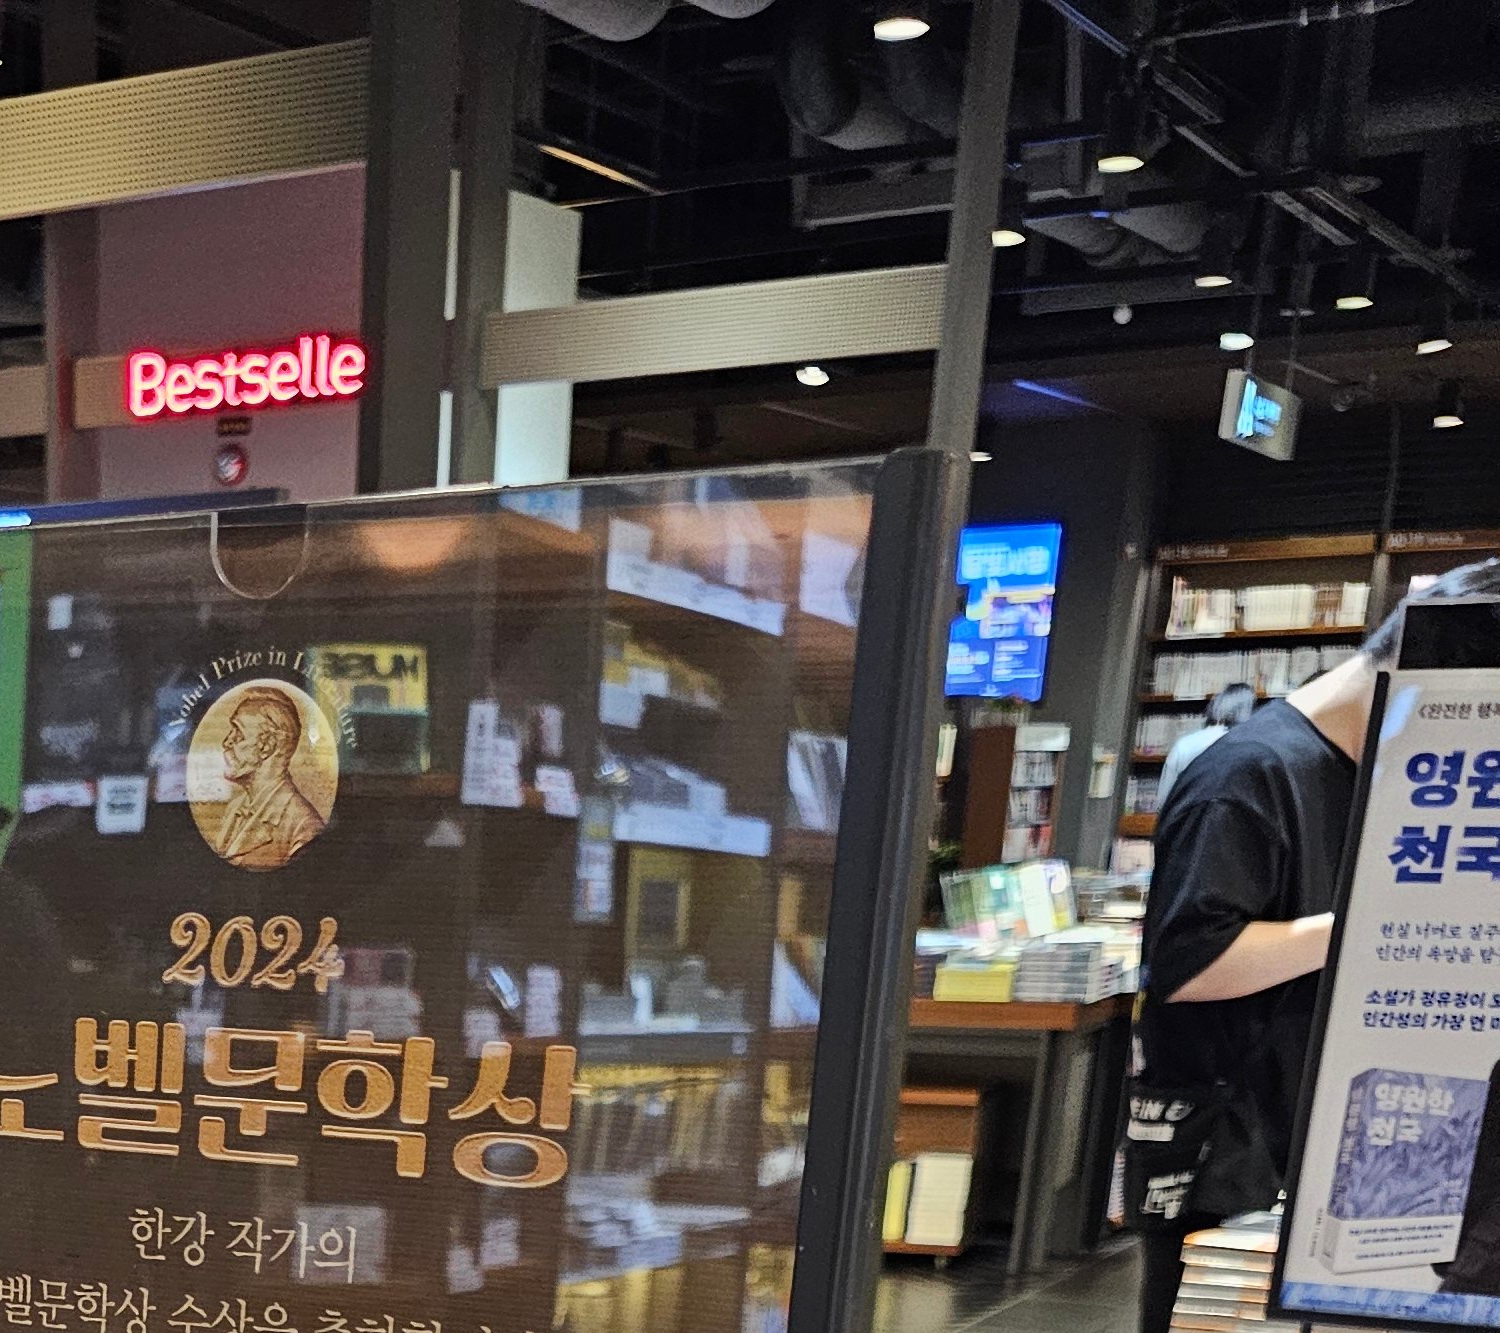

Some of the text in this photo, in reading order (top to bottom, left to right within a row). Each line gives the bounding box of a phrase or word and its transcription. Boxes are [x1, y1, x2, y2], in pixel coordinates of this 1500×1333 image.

[209, 650, 262, 681] Prize
[267, 645, 287, 667] in
[161, 911, 346, 993] 2024
[1375, 943, 1423, 962] 인간의
[1363, 988, 1416, 1007] 소설가
[1420, 989, 1486, 1009] 정유정이
[1362, 1009, 1428, 1030] 인간성의
[1430, 1012, 1466, 1031] 가장
[128, 1206, 358, 1285] 한강 작가의
